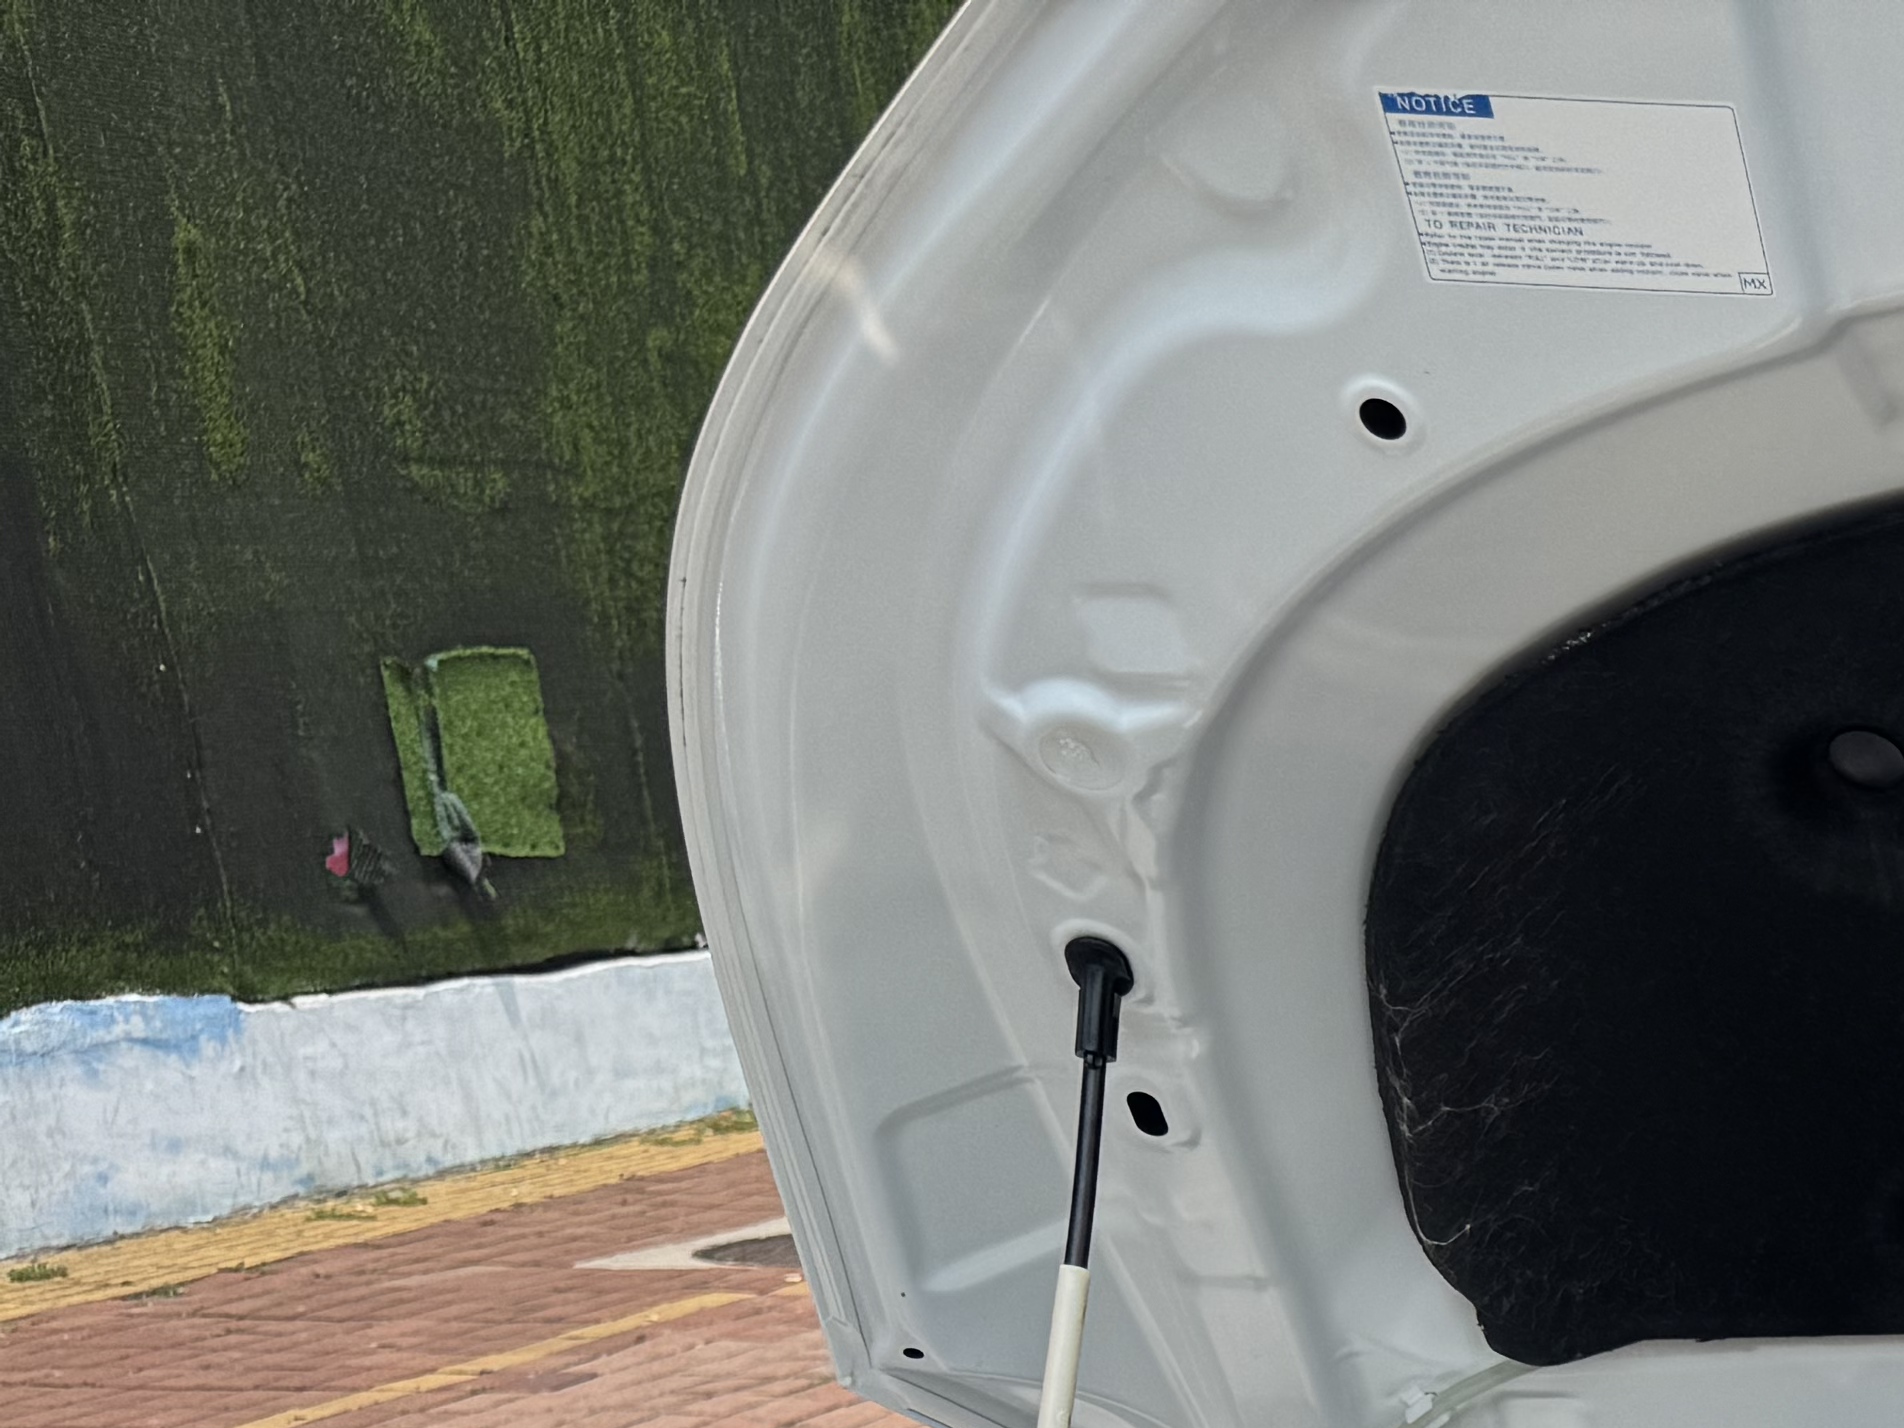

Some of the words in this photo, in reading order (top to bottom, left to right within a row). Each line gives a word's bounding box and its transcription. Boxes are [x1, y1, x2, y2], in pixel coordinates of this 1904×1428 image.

[1396, 95, 1477, 115] NOTICE
[1424, 218, 1444, 231] TO
[1449, 219, 1498, 234] REPAIR
[1505, 221, 1585, 238] TECHNICIAN
[1744, 278, 1767, 291] MX
